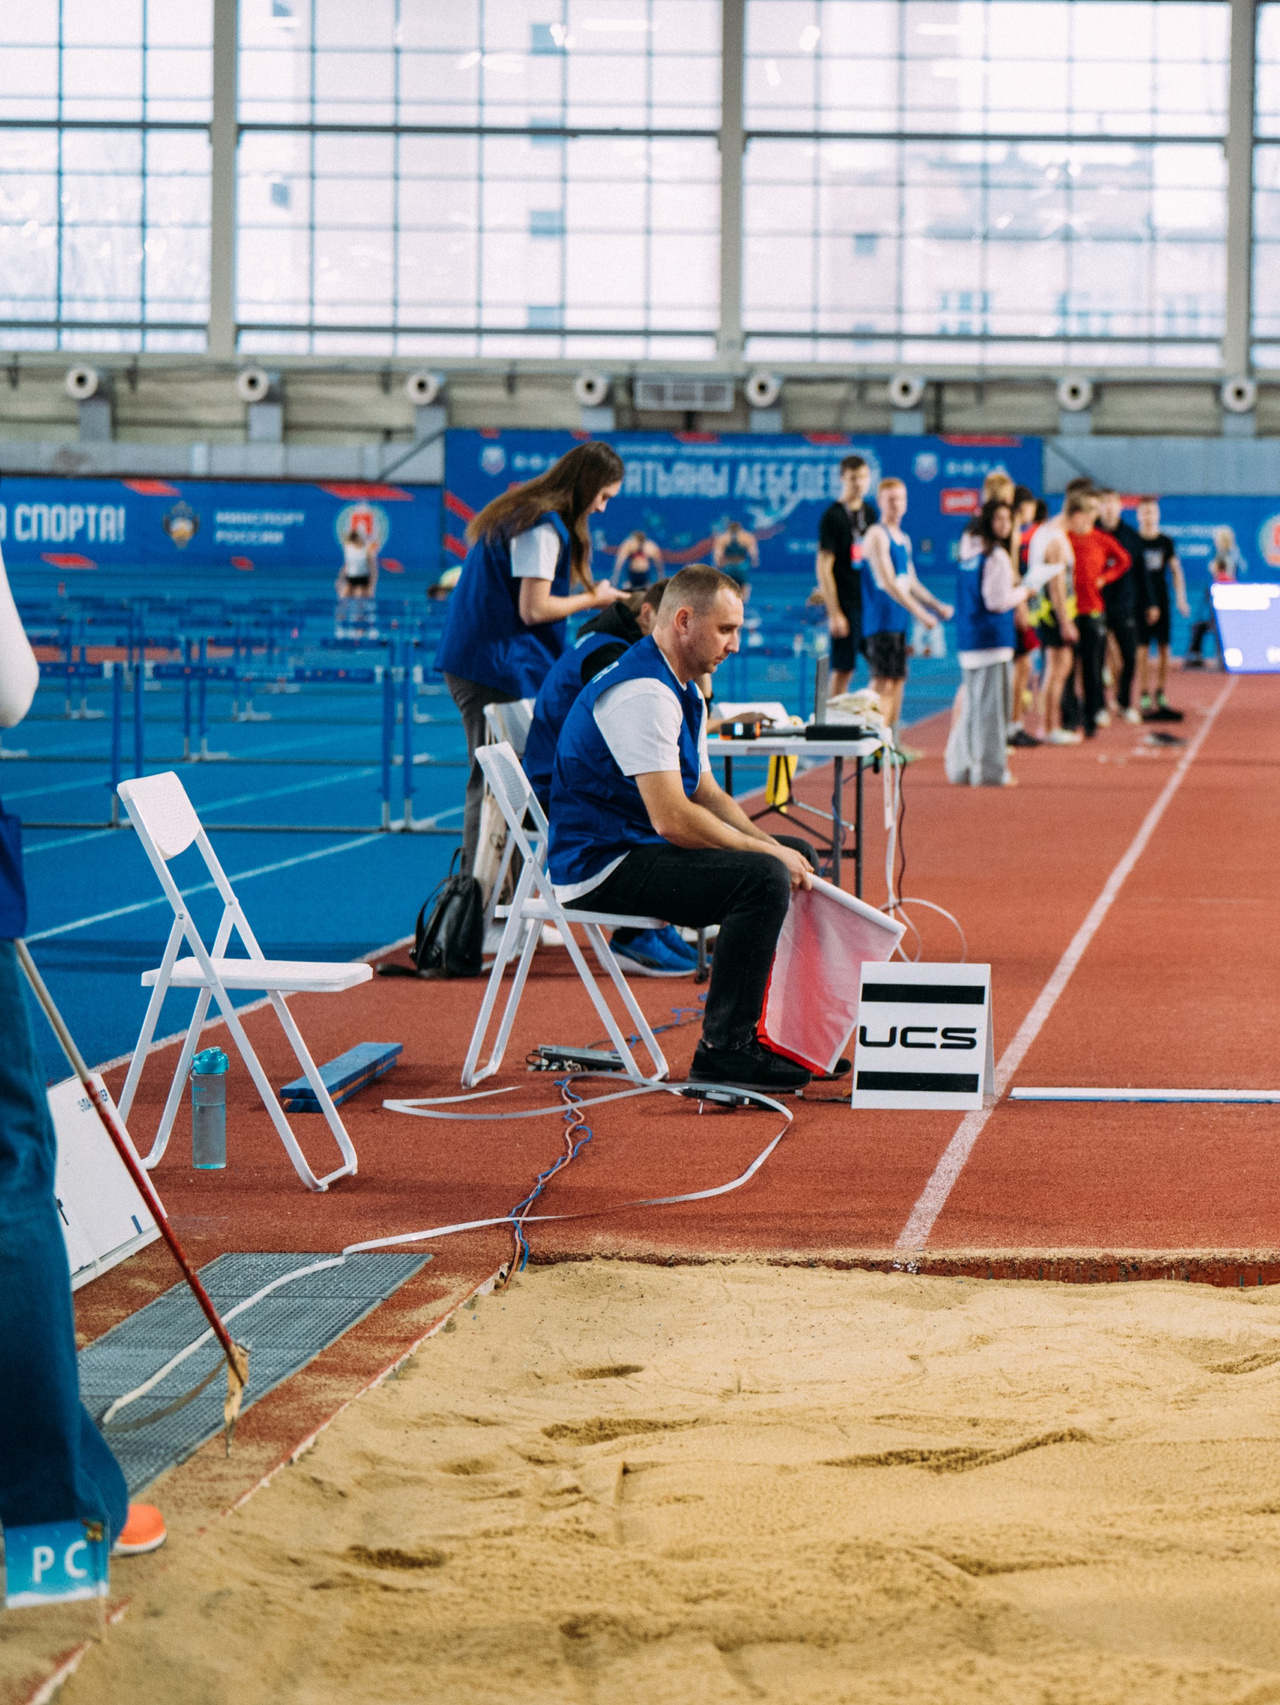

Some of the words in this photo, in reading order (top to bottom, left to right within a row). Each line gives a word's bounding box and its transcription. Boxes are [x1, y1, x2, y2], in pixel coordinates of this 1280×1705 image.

[624, 460, 729, 498] АТЬЯНЫ
[734, 462, 880, 501] ЛЕБЕДЕВ
[14, 503, 126, 544] СПОРТА!
[859, 1025, 977, 1050] UCS
